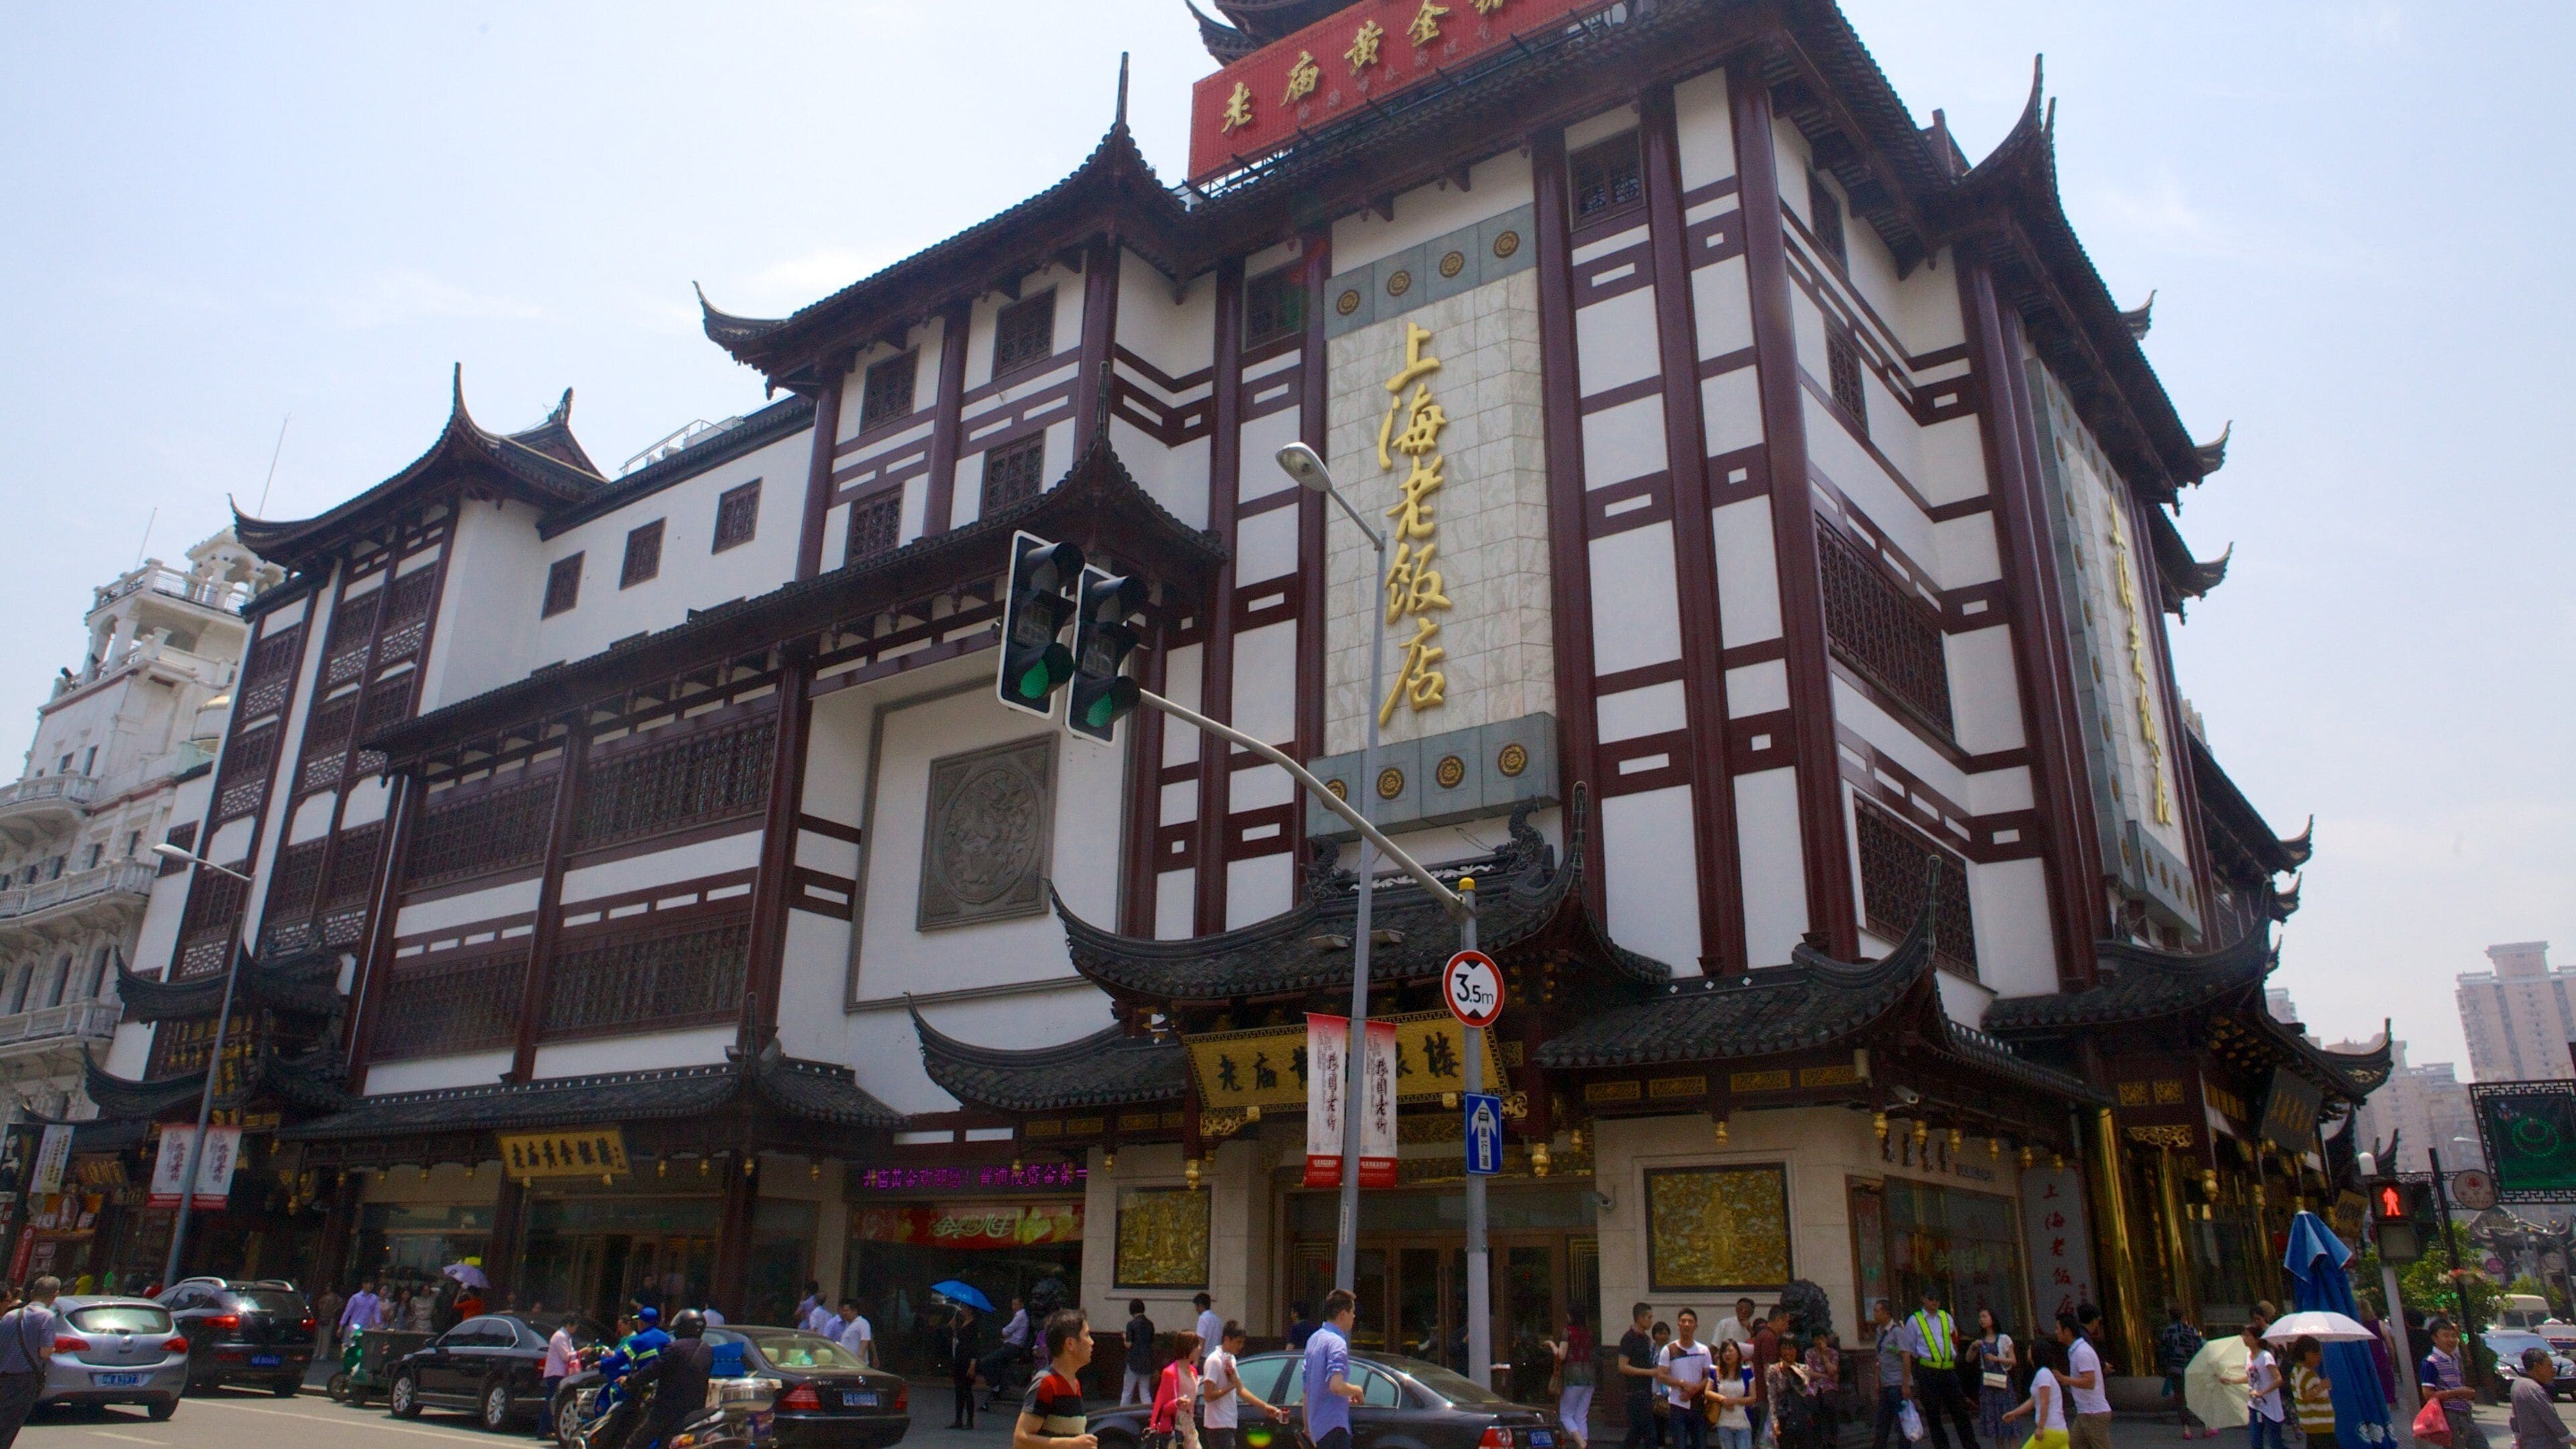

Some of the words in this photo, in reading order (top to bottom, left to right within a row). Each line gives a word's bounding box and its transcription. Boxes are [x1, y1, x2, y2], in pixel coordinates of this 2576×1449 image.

[1378, 321, 1452, 729] 上海老饭店
[1454, 973, 1495, 1006] 3.5m
